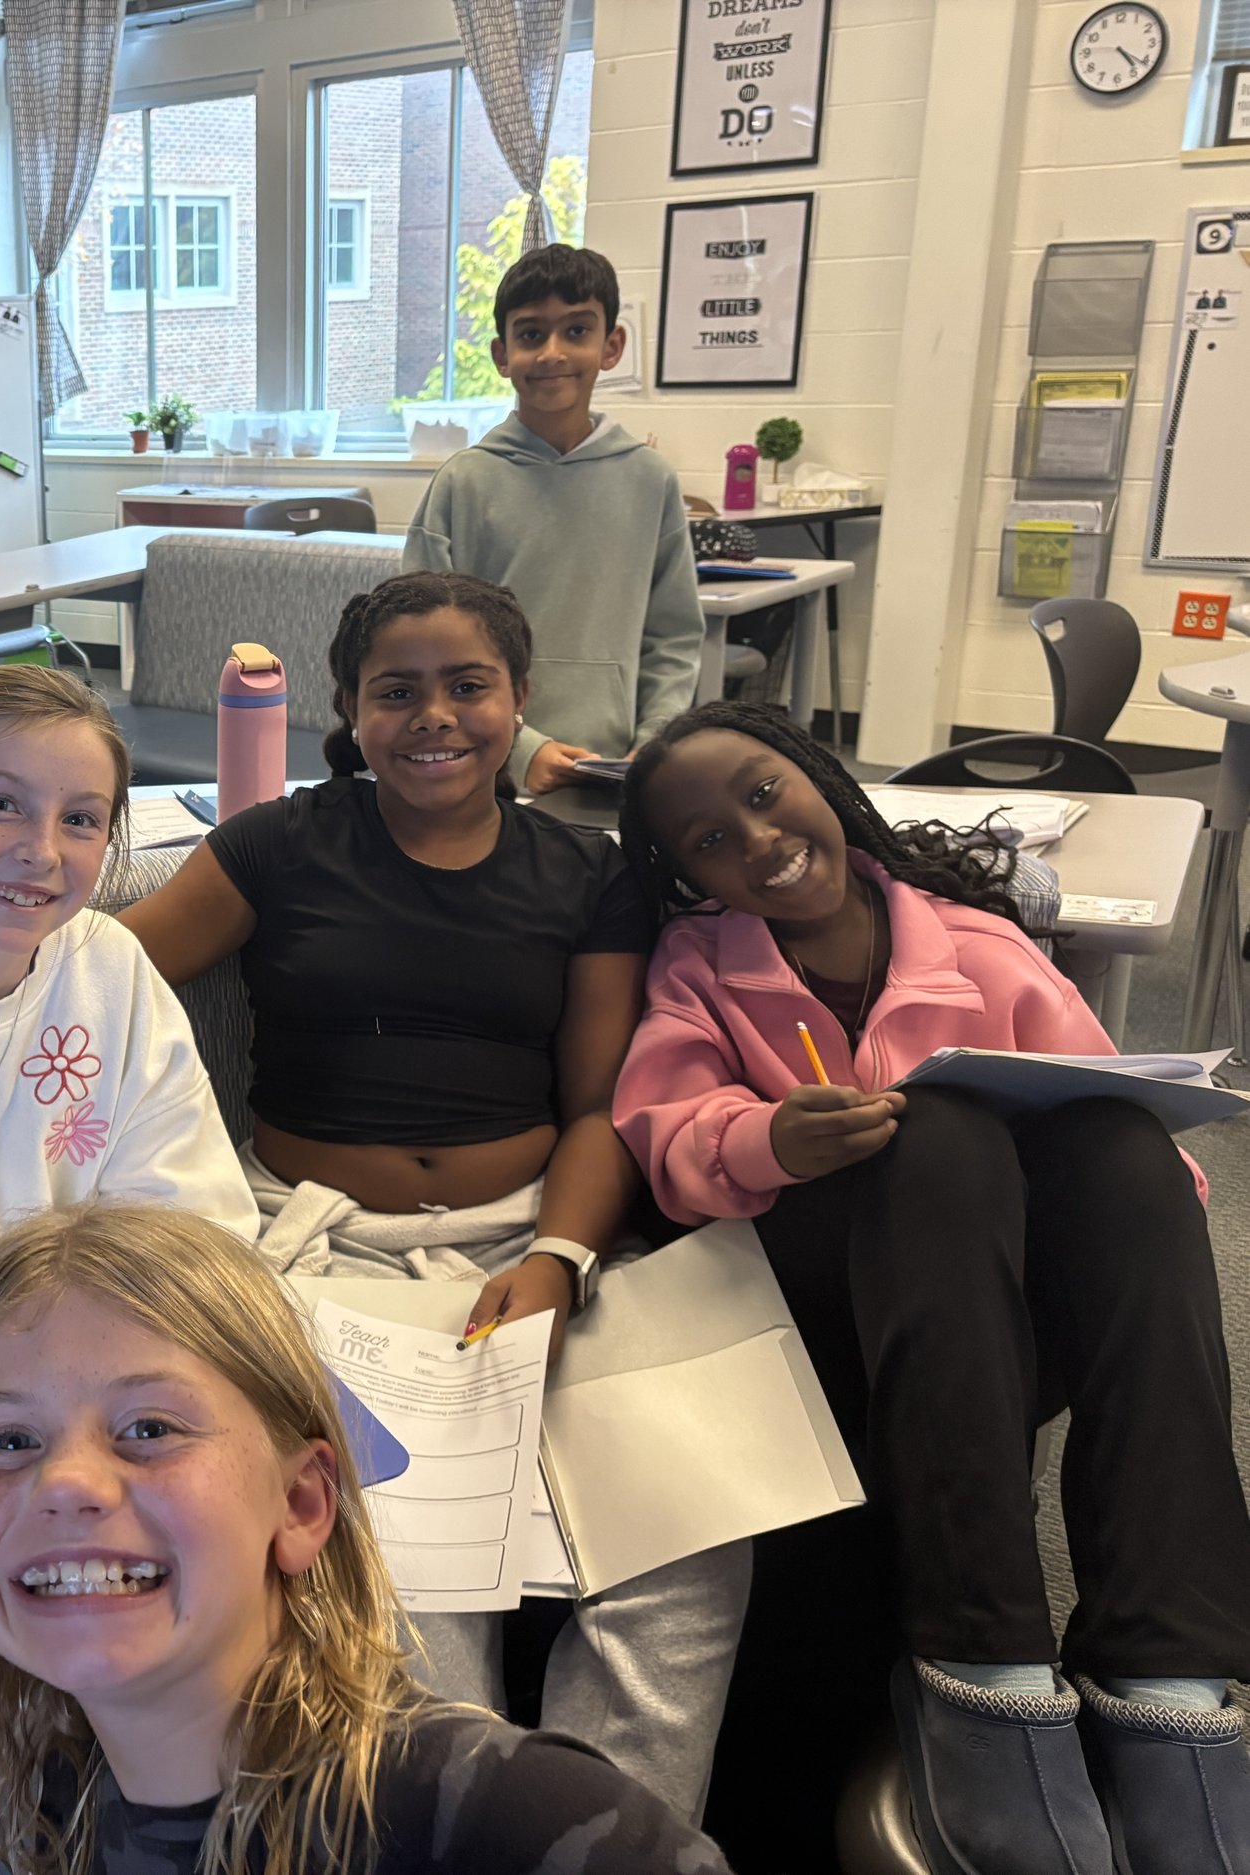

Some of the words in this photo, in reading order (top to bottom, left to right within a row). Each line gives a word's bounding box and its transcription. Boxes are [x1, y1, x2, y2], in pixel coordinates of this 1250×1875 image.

[1116, 12, 1126, 23] 12
[1134, 14, 1138, 24] 1
[735, 18, 770, 36] don't
[1102, 20, 1107, 29] 11
[1144, 23, 1152, 33] 2
[1089, 32, 1099, 42] 10
[1149, 38, 1156, 48] 3
[718, 39, 787, 58] WORK
[1083, 48, 1091, 58] 9
[726, 61, 774, 81] UNLESS
[1087, 63, 1095, 72] 8
[1130, 67, 1137, 77] 5
[1098, 72, 1105, 81] 7
[1114, 74, 1121, 83] 6
[719, 106, 772, 139] DO
[1209, 229, 1221, 244] 9
[709, 242, 761, 256] ENJOY
[706, 301, 756, 315] LITTLE
[699, 331, 758, 344] THINGS
[339, 1320, 390, 1348] Teach
